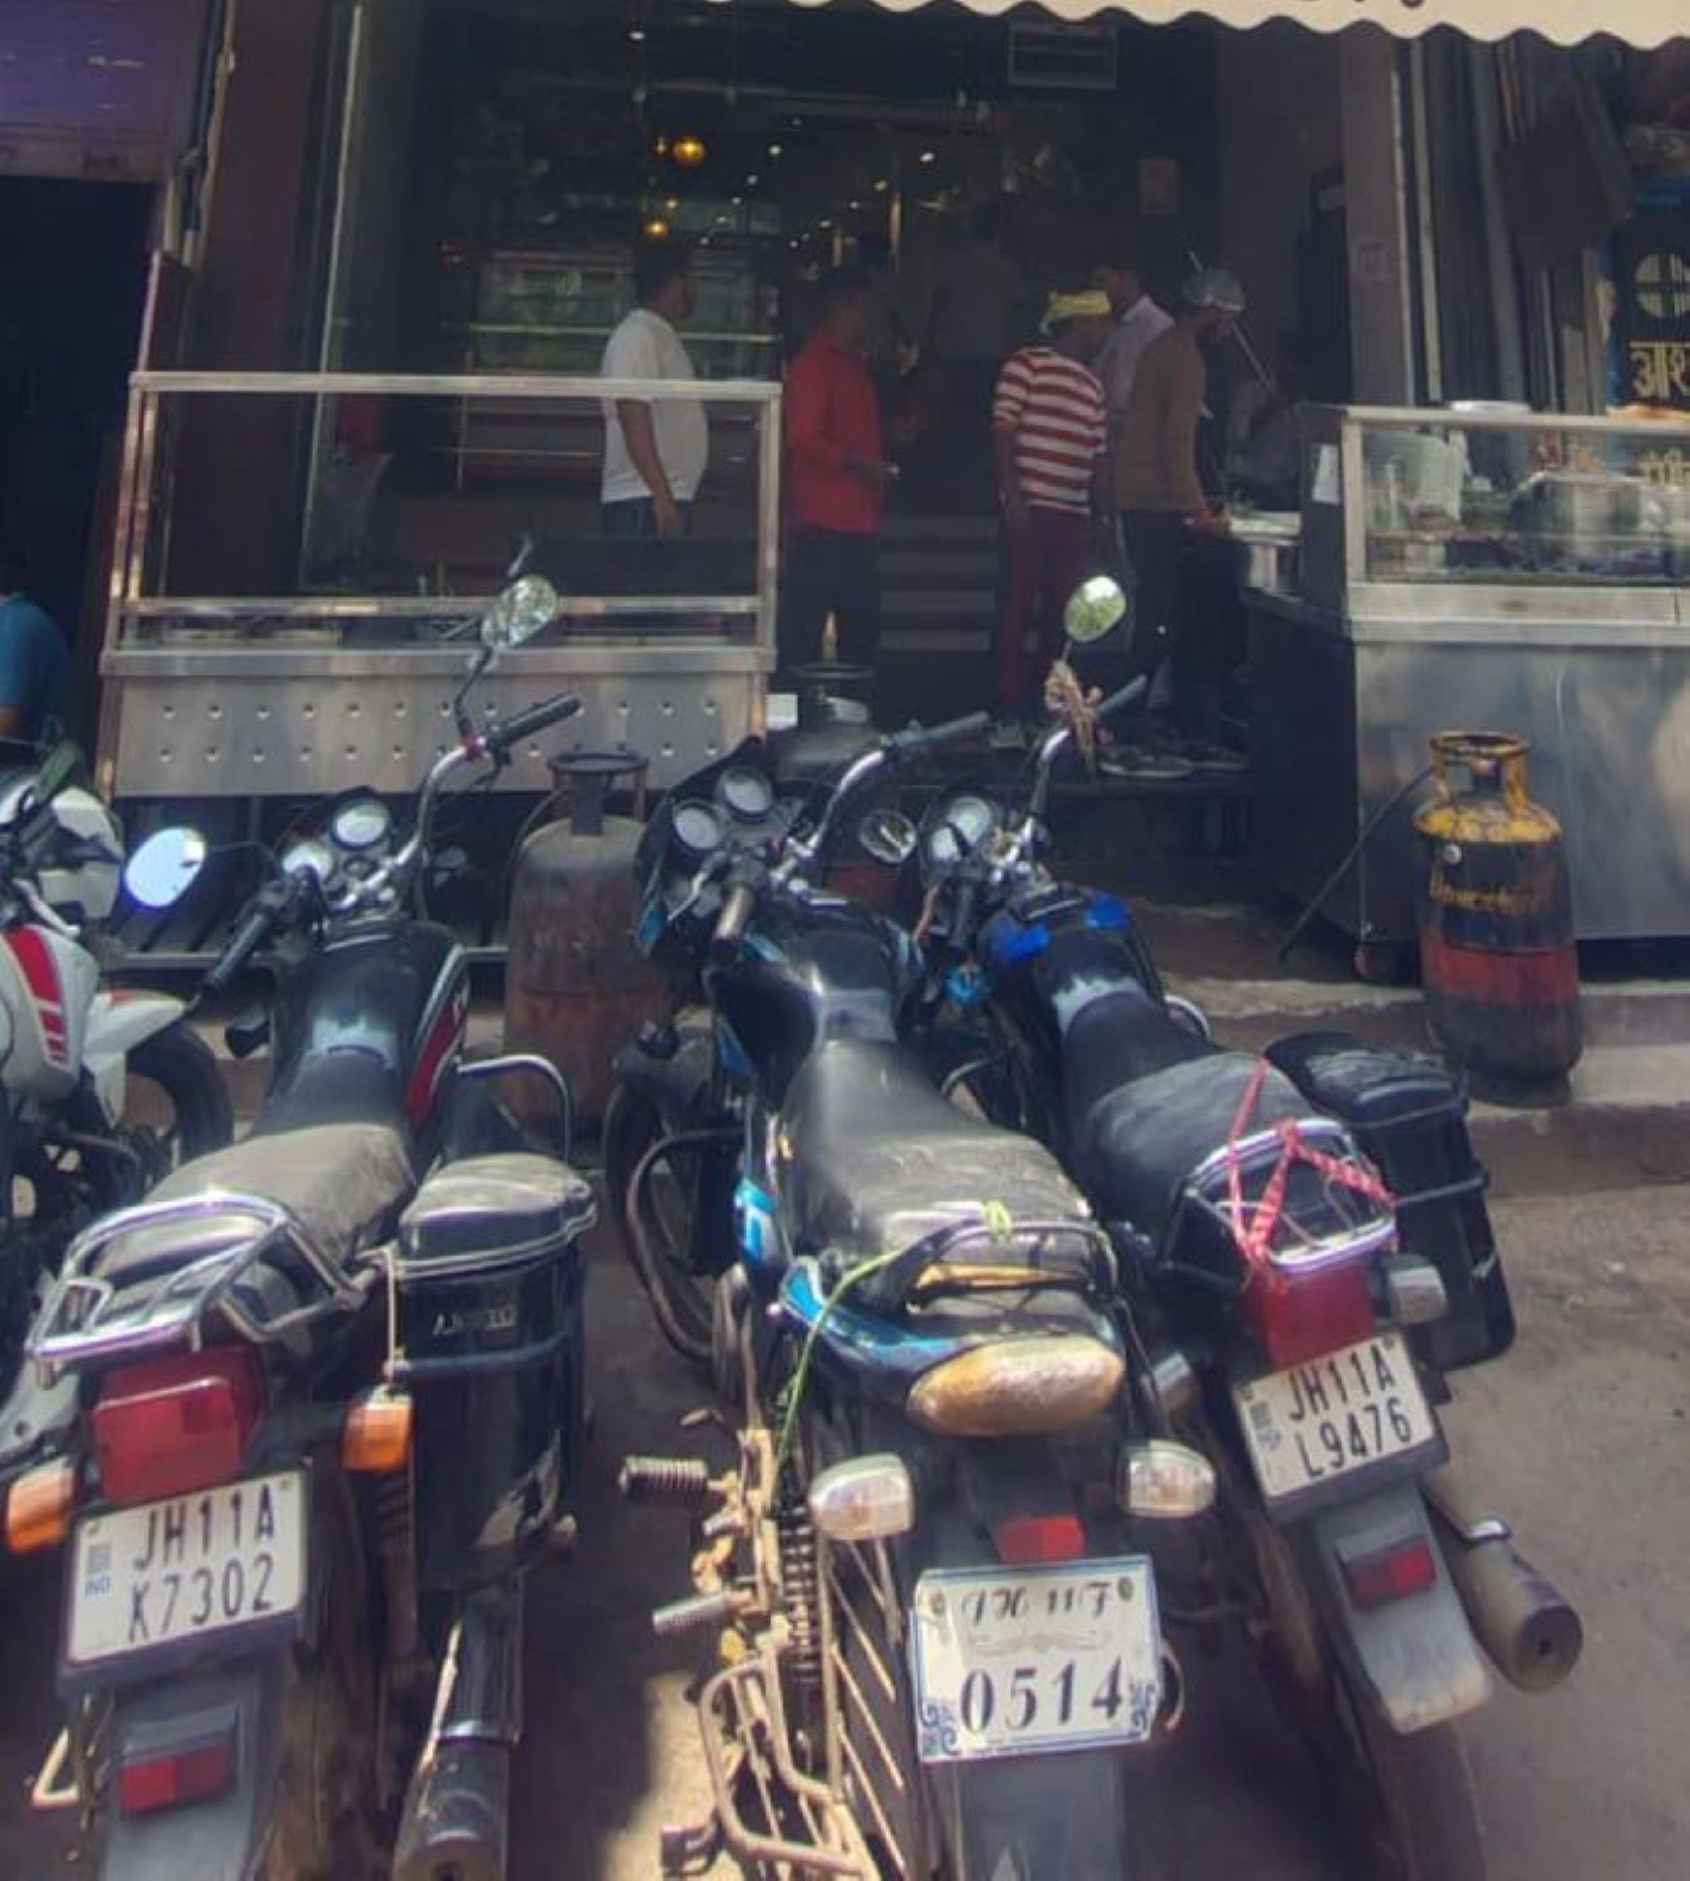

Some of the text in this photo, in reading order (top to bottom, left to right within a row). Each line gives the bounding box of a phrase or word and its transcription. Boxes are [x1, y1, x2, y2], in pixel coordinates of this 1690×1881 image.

[1289, 1343, 1396, 1423] JH11A
[1294, 1396, 1412, 1478] L9476
[132, 1483, 275, 1572] JH11A
[128, 1553, 274, 1643] K7302
[959, 1655, 1123, 1733] 0514
